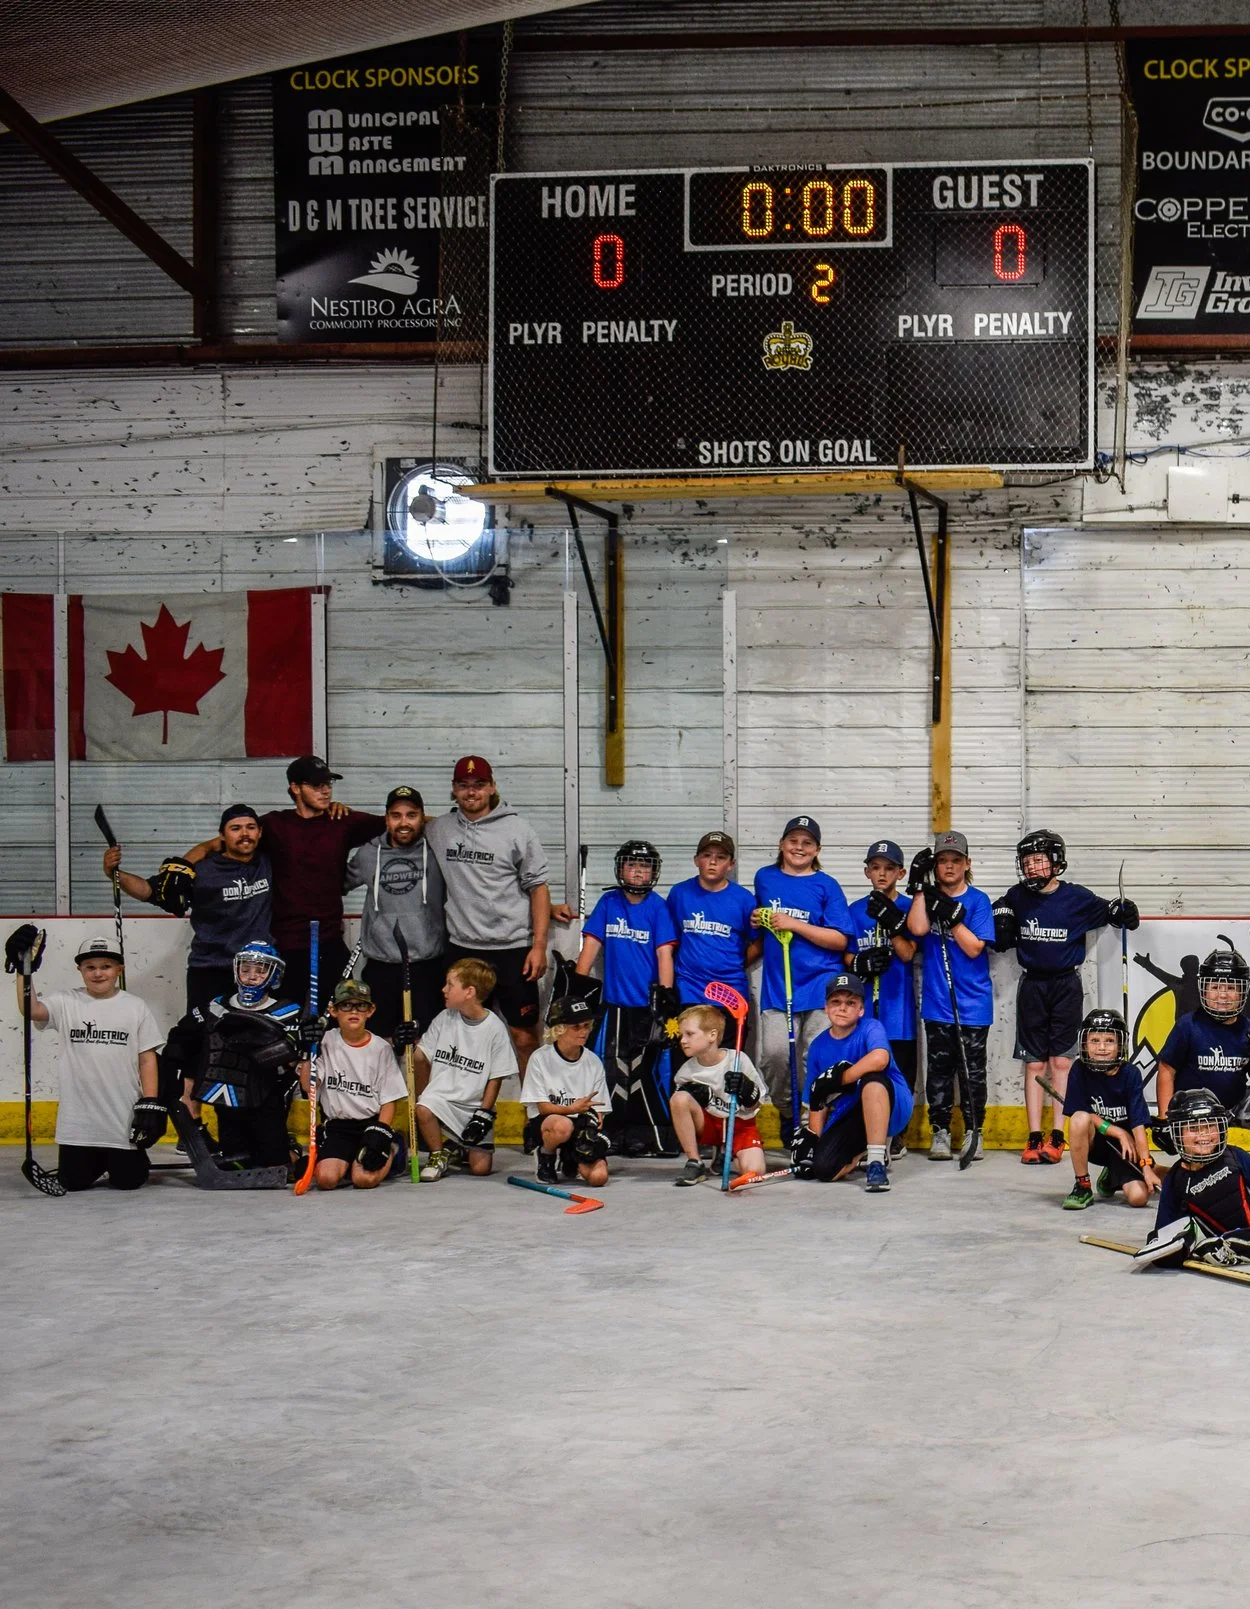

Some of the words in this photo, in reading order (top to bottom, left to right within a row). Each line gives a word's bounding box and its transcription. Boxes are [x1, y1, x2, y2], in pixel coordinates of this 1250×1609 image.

[290, 69, 359, 90] CLOCK
[365, 65, 479, 87] SPONSORS
[1144, 59, 1219, 79] CLOCK
[308, 109, 440, 129] MUNICIPAL
[308, 133, 393, 153] WASTE
[308, 155, 466, 175] MANAGEMENT
[753, 164, 823, 172] DAKTRONICS
[541, 184, 636, 218] HOME
[932, 174, 1044, 210] GUEST
[288, 201, 300, 231] D
[306, 200, 320, 231] &
[326, 200, 342, 231] M
[348, 198, 397, 230] TREE
[742, 180, 875, 236] 0:00
[593, 234, 623, 287] 0
[995, 225, 1025, 280] 0
[712, 273, 793, 297] PERIOD
[811, 264, 834, 303] 2
[311, 296, 395, 317] NESTIBO
[403, 295, 461, 316] AGRA
[309, 319, 375, 330] COMMODITY
[509, 323, 562, 344] PLYR
[582, 320, 678, 343] PENALTY
[898, 314, 953, 338] PLYR
[974, 311, 1073, 336] PENALTY
[699, 440, 771, 464] SHOTS
[780, 440, 809, 463] ON
[819, 439, 877, 463] GOAL
[1035, 928, 1067, 937] DIETRICH
[71, 1029, 86, 1039] DON
[1197, 1055, 1214, 1066] DON
